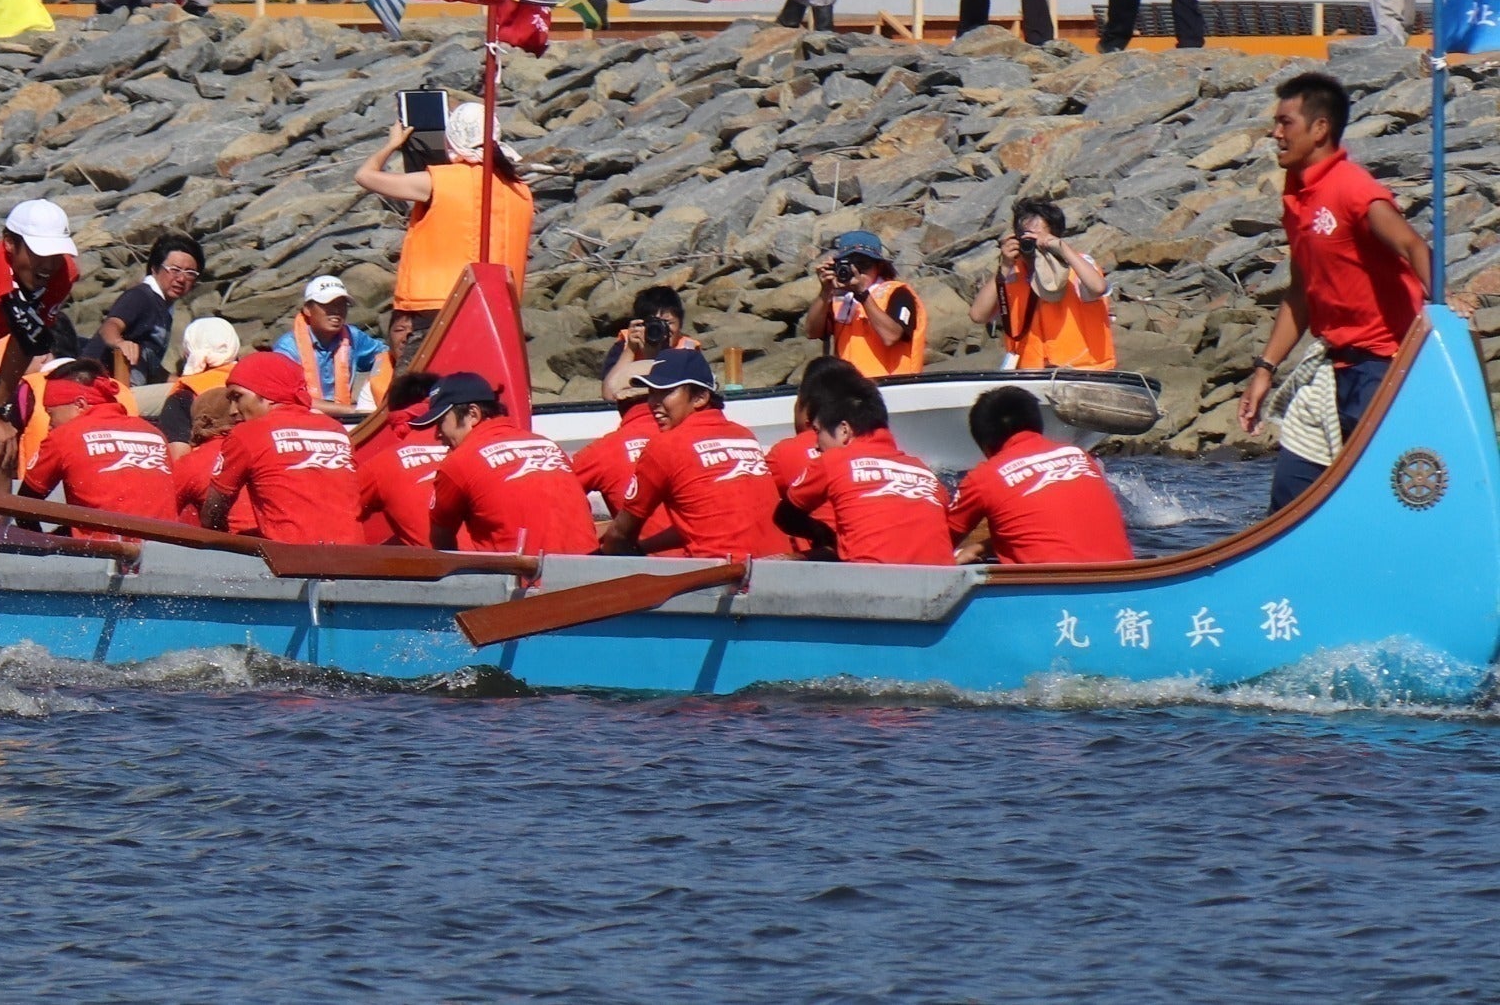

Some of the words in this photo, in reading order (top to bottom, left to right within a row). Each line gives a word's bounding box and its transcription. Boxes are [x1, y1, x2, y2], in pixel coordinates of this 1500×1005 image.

[87, 442, 115, 456] Fire
[275, 440, 303, 454] Fire
[487, 451, 515, 468] Fire
[700, 451, 728, 467] Fire
[852, 469, 881, 482] Fire
[1004, 468, 1034, 487] Fire
